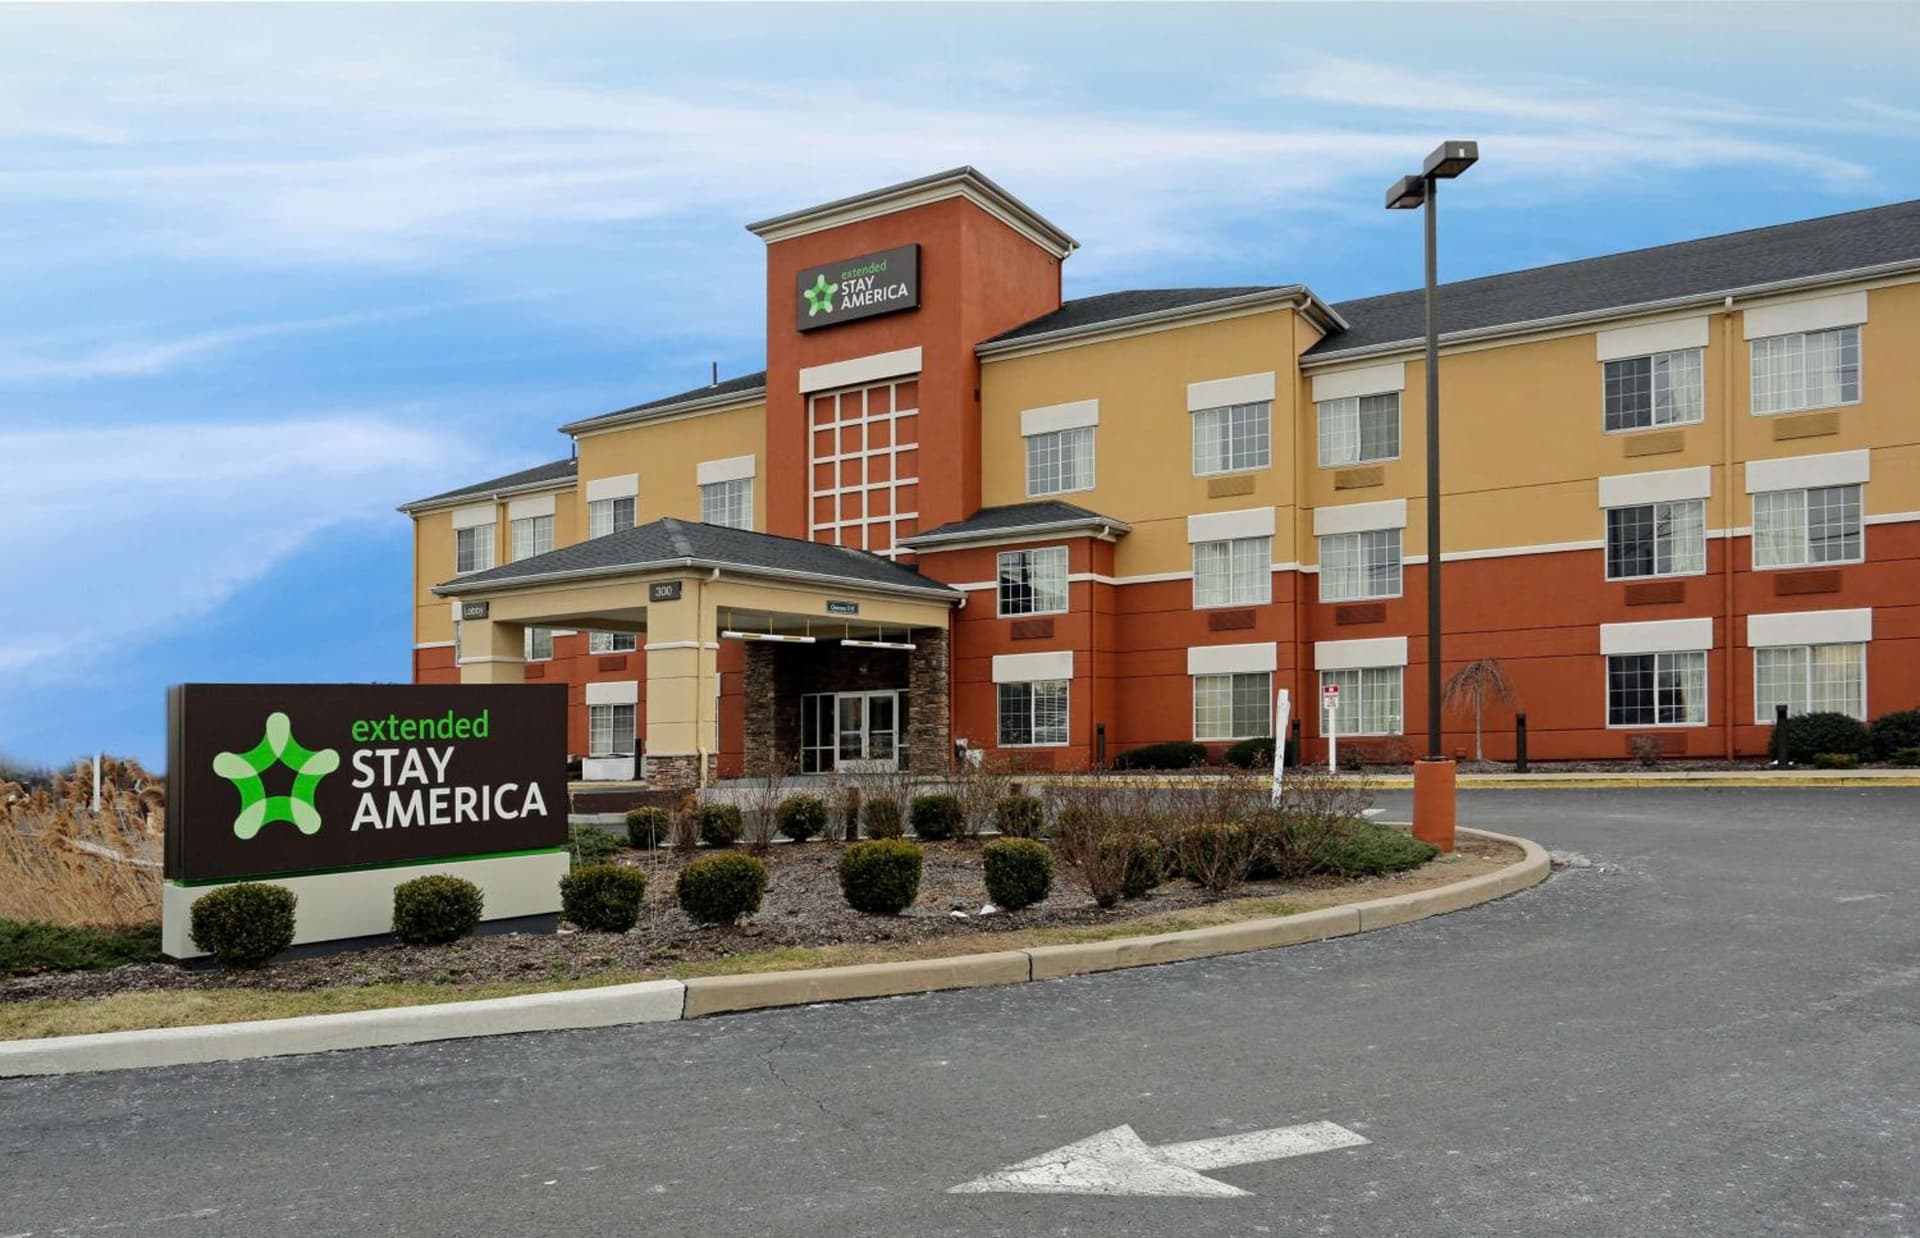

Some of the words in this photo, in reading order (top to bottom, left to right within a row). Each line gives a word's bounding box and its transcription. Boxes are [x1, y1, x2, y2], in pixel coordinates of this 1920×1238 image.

[841, 259, 888, 281] extended
[840, 282, 909, 311] AMERICA
[841, 275, 875, 296] STAY
[655, 585, 673, 597] 300
[351, 709, 489, 742] extended
[351, 746, 455, 789] STAY
[350, 781, 549, 832] AMERICA
